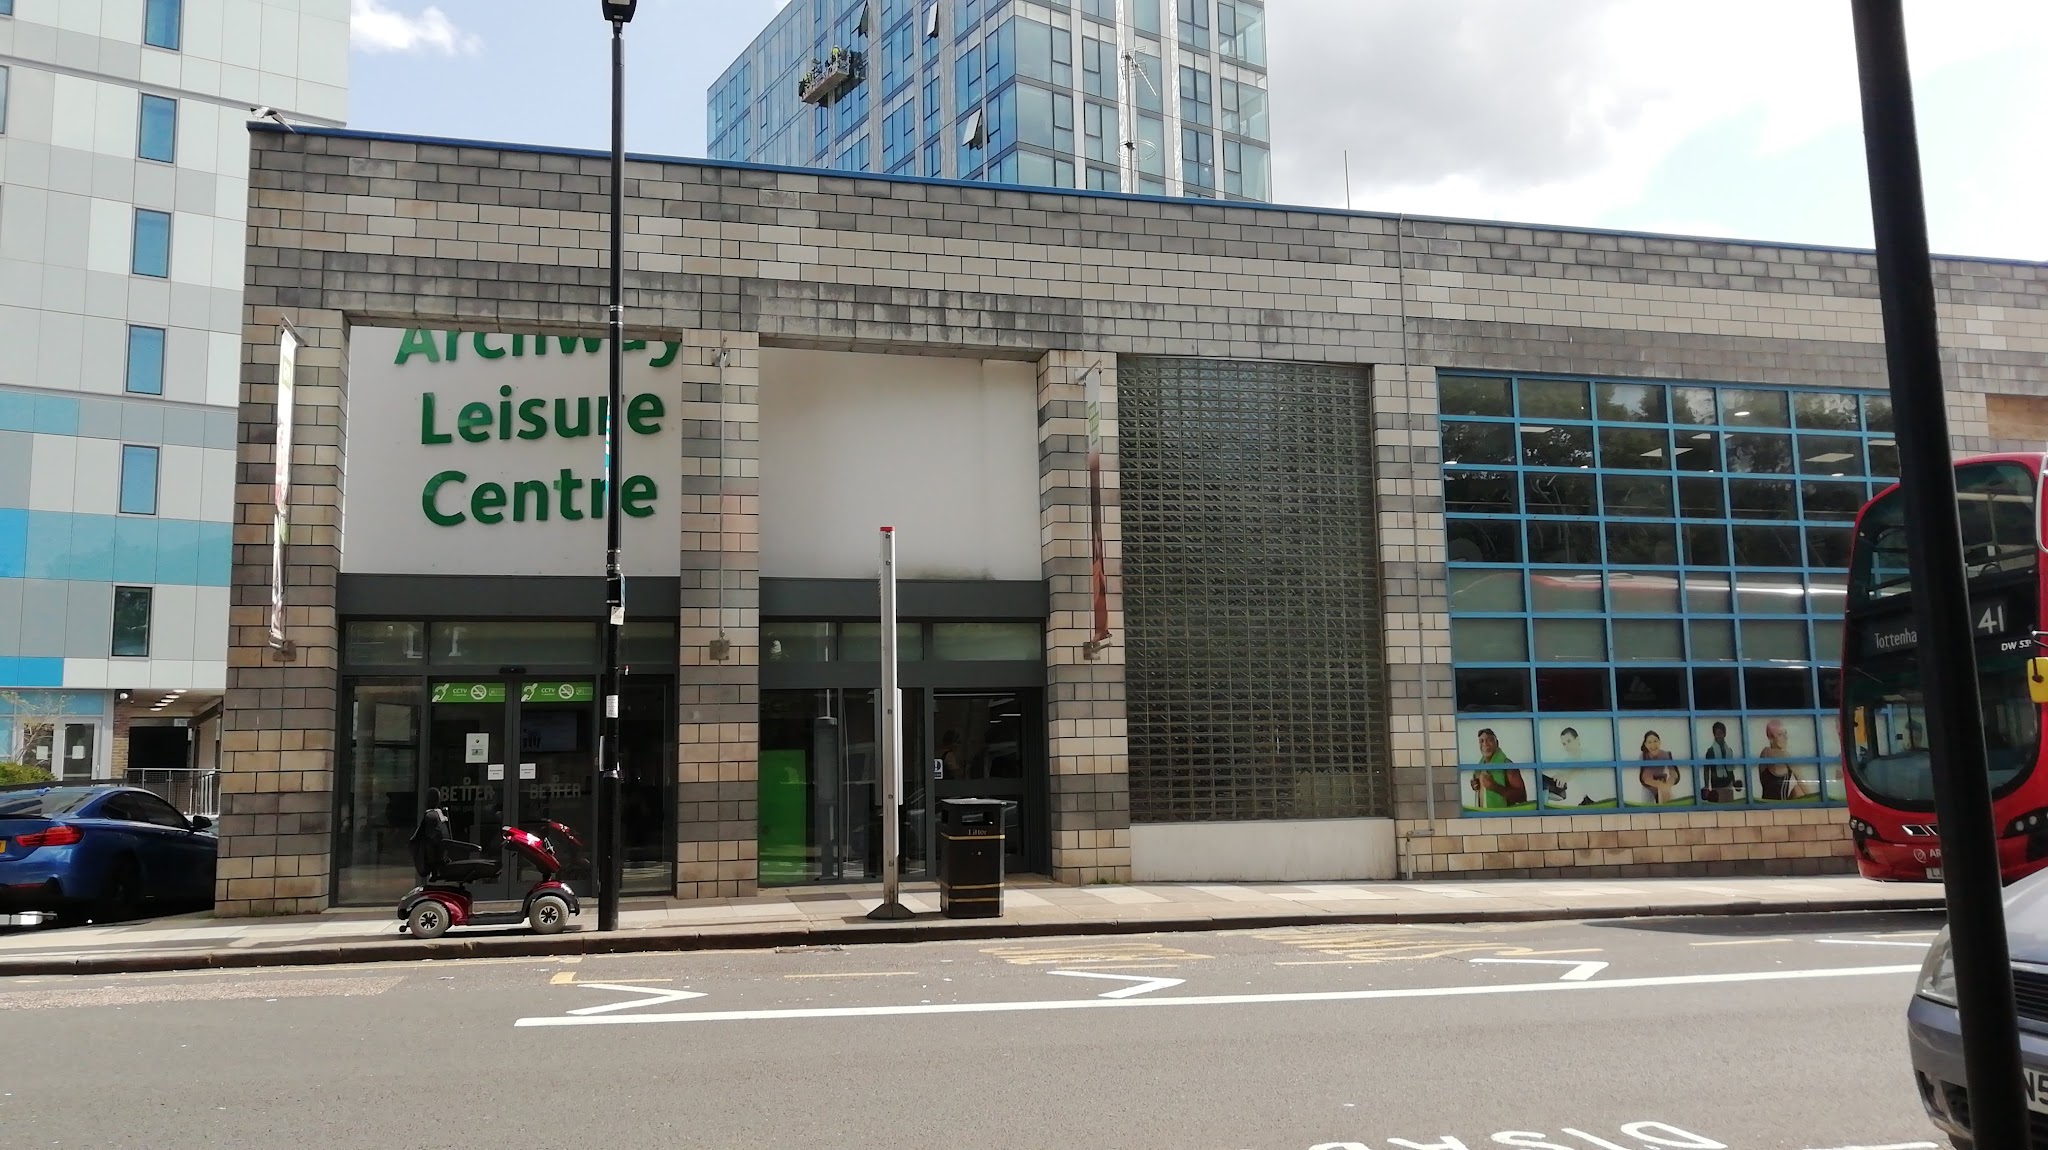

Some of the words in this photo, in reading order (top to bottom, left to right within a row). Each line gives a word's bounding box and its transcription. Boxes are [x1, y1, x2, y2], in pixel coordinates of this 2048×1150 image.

[421, 384, 665, 444] Leisure
[422, 468, 657, 527] Centre
[1978, 605, 2004, 633] 41
[1874, 627, 1918, 649] Tottenha
[2001, 641, 2017, 651] DW
